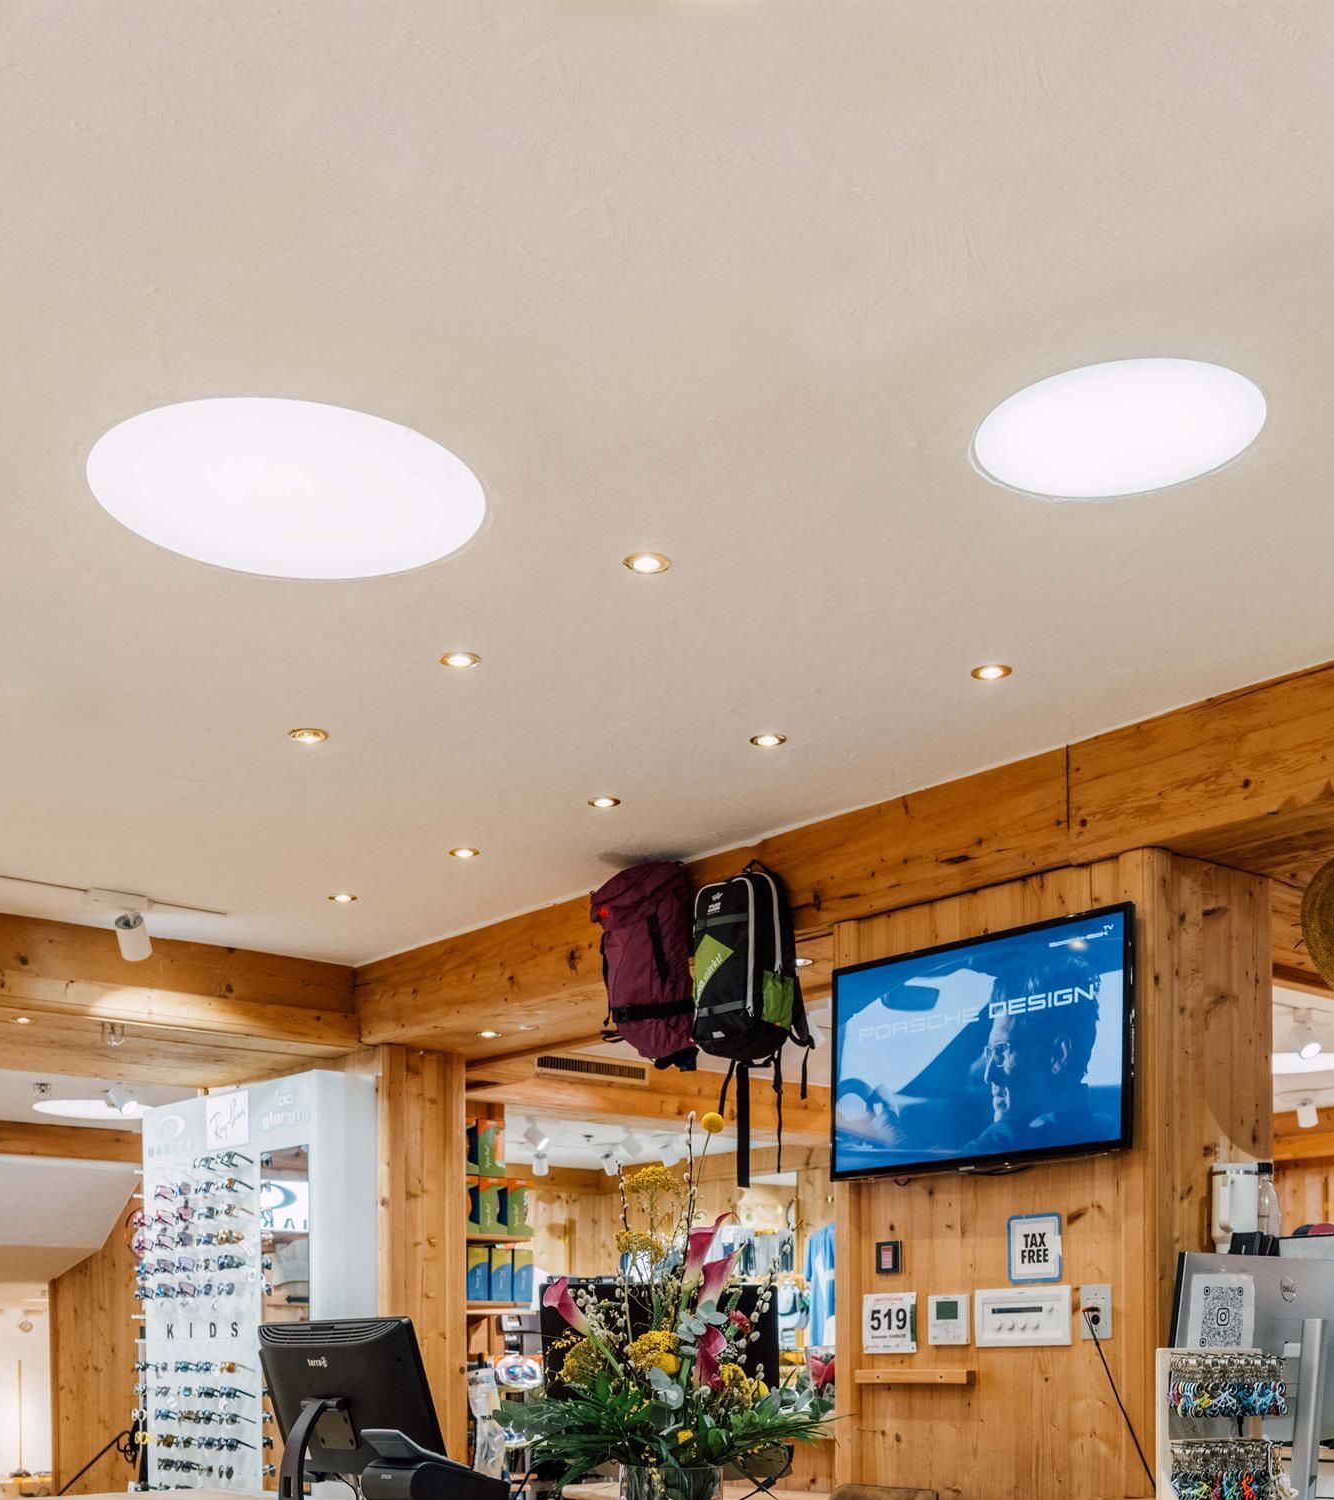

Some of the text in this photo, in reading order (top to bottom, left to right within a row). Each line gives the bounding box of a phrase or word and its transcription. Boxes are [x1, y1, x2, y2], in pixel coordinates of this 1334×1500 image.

[858, 983, 1095, 1043] PORSCHE DESIGN
[1023, 1232, 1046, 1248] TAX
[1021, 1248, 1049, 1264] FREE
[1282, 1285, 1296, 1293] DELL
[870, 1308, 907, 1331] 519
